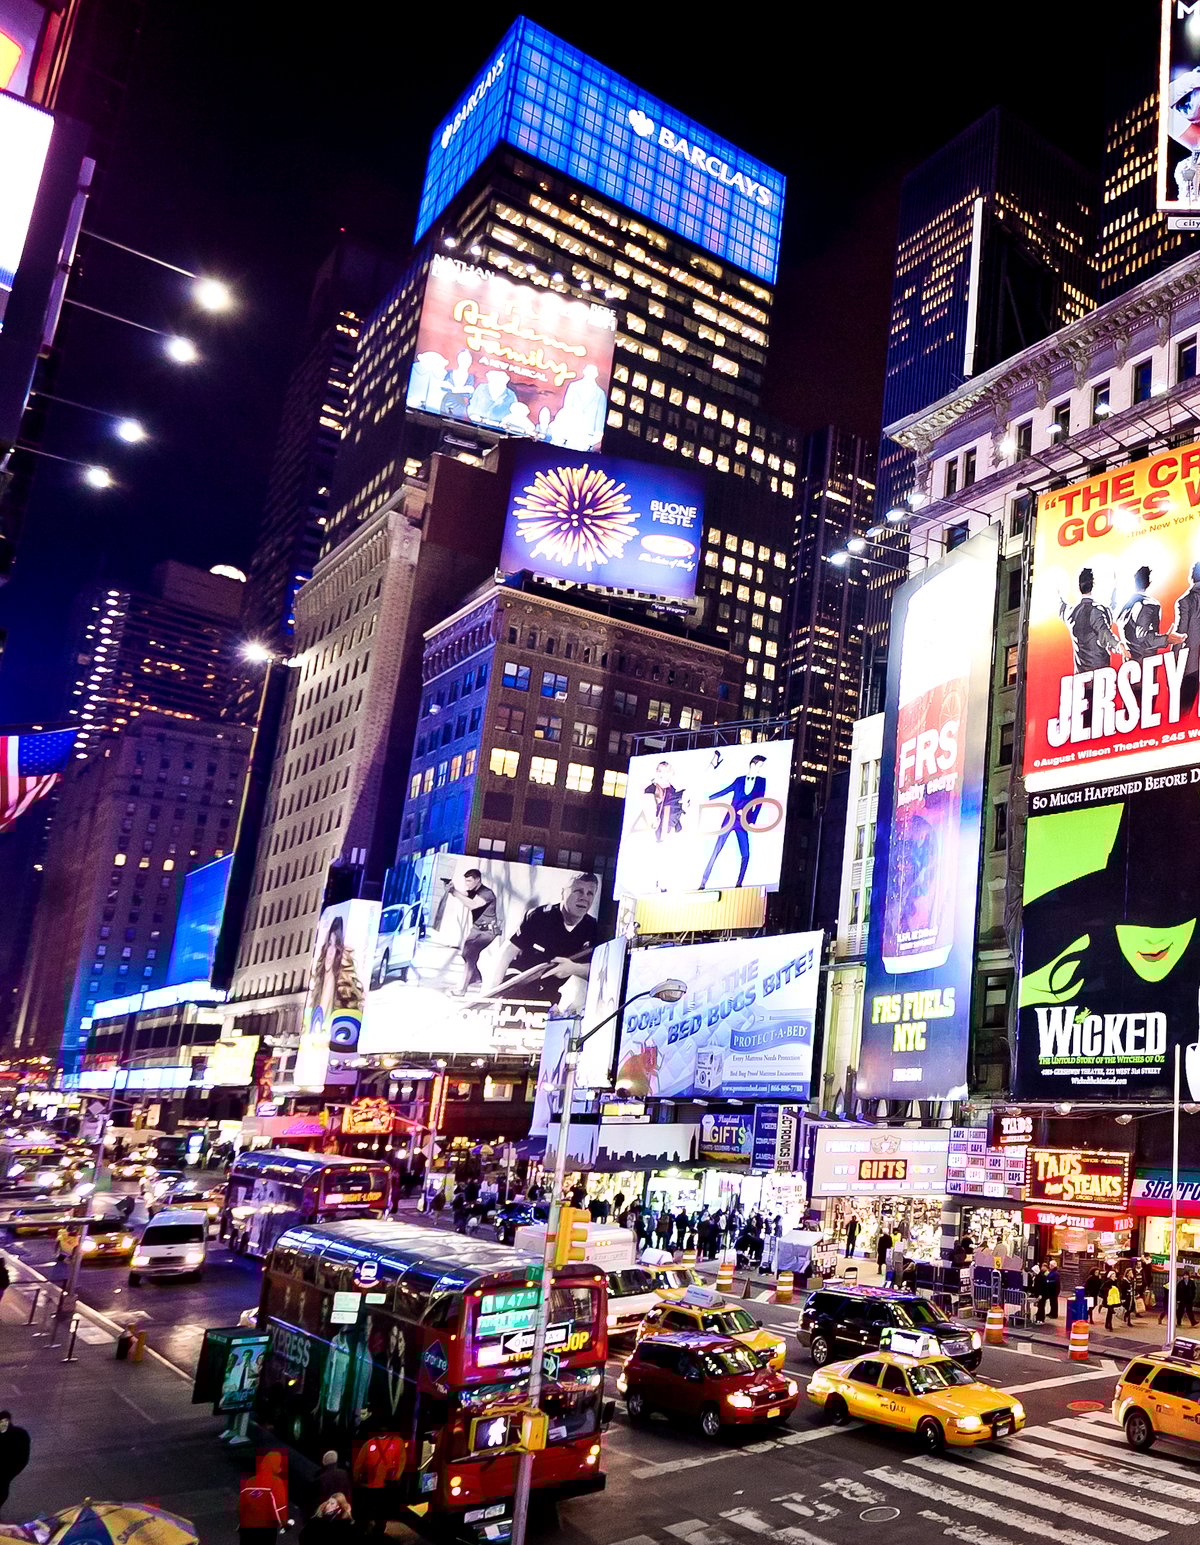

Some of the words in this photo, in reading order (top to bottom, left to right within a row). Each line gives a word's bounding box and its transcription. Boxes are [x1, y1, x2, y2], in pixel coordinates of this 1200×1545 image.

[450, 53, 505, 134] BARCLAYS
[658, 127, 770, 205] BARCLAYS
[1183, 220, 1200, 228] city
[434, 254, 495, 279] NATHAN
[453, 299, 587, 357] Addams
[463, 325, 577, 387] Family
[650, 500, 697, 518] BUONE
[652, 511, 693, 528] FESTE.
[1057, 491, 1170, 547] GOES
[1150, 520, 1170, 534] New
[1173, 513, 1195, 528] York
[1047, 649, 1189, 747] JERSEY
[899, 720, 960, 788] FRS
[1040, 753, 1075, 768] August
[1077, 747, 1110, 760] Wilson
[1113, 739, 1159, 753] Theatre,
[1162, 733, 1185, 744] 245
[722, 958, 759, 988] THE
[667, 1013, 702, 1045] BED
[707, 984, 756, 1027] BUGS
[763, 948, 814, 998] BITE!
[871, 994, 901, 1024] FRS
[902, 987, 955, 1021] FUELS
[893, 1022, 927, 1053] NYC
[711, 1126, 746, 1144] GIFTS
[971, 1144, 982, 1152] CAPS
[860, 1160, 906, 1179] GIFTS
[989, 1159, 1001, 1167] CAPS
[1063, 1175, 1122, 1200] STEAKS
[508, 1293, 524, 1306] 47
[515, 1337, 533, 1346] ONE
